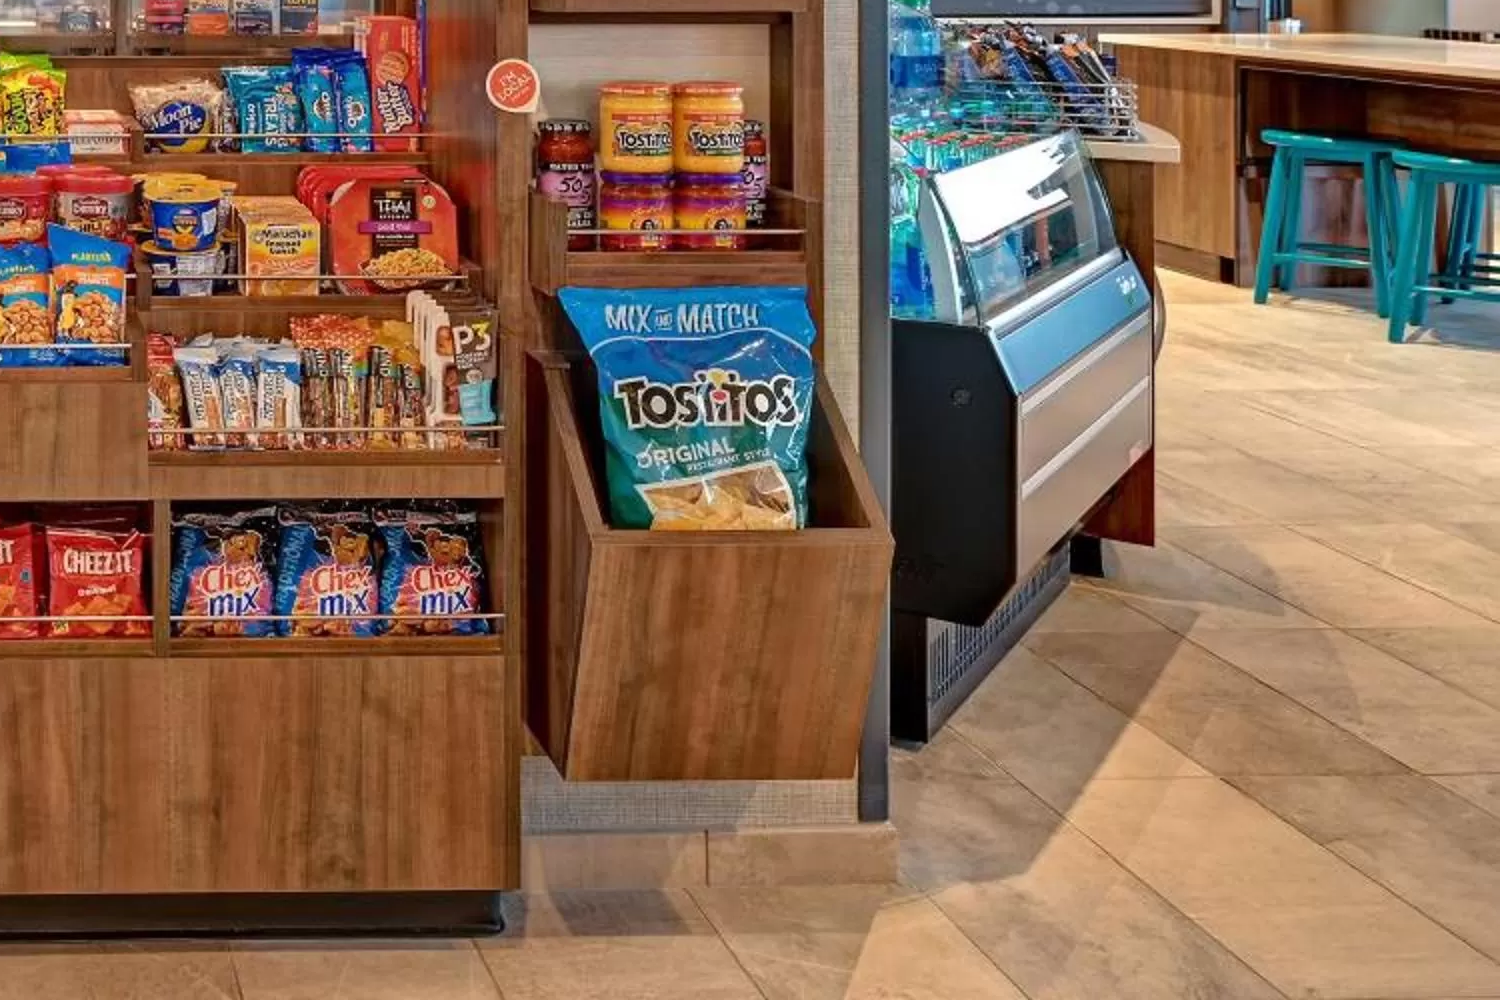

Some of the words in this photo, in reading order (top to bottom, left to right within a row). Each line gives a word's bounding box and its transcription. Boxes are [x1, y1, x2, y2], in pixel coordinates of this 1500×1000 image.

[605, 304, 651, 332] MIX
[677, 304, 758, 333] MATCH
[452, 322, 491, 354] P3
[636, 437, 735, 468] ORIGINAL
[201, 566, 262, 594] Chex
[311, 566, 371, 594] Chex
[412, 566, 472, 592] Chex
[210, 588, 259, 616] mix
[320, 589, 368, 616] mix
[421, 587, 470, 614] mix
